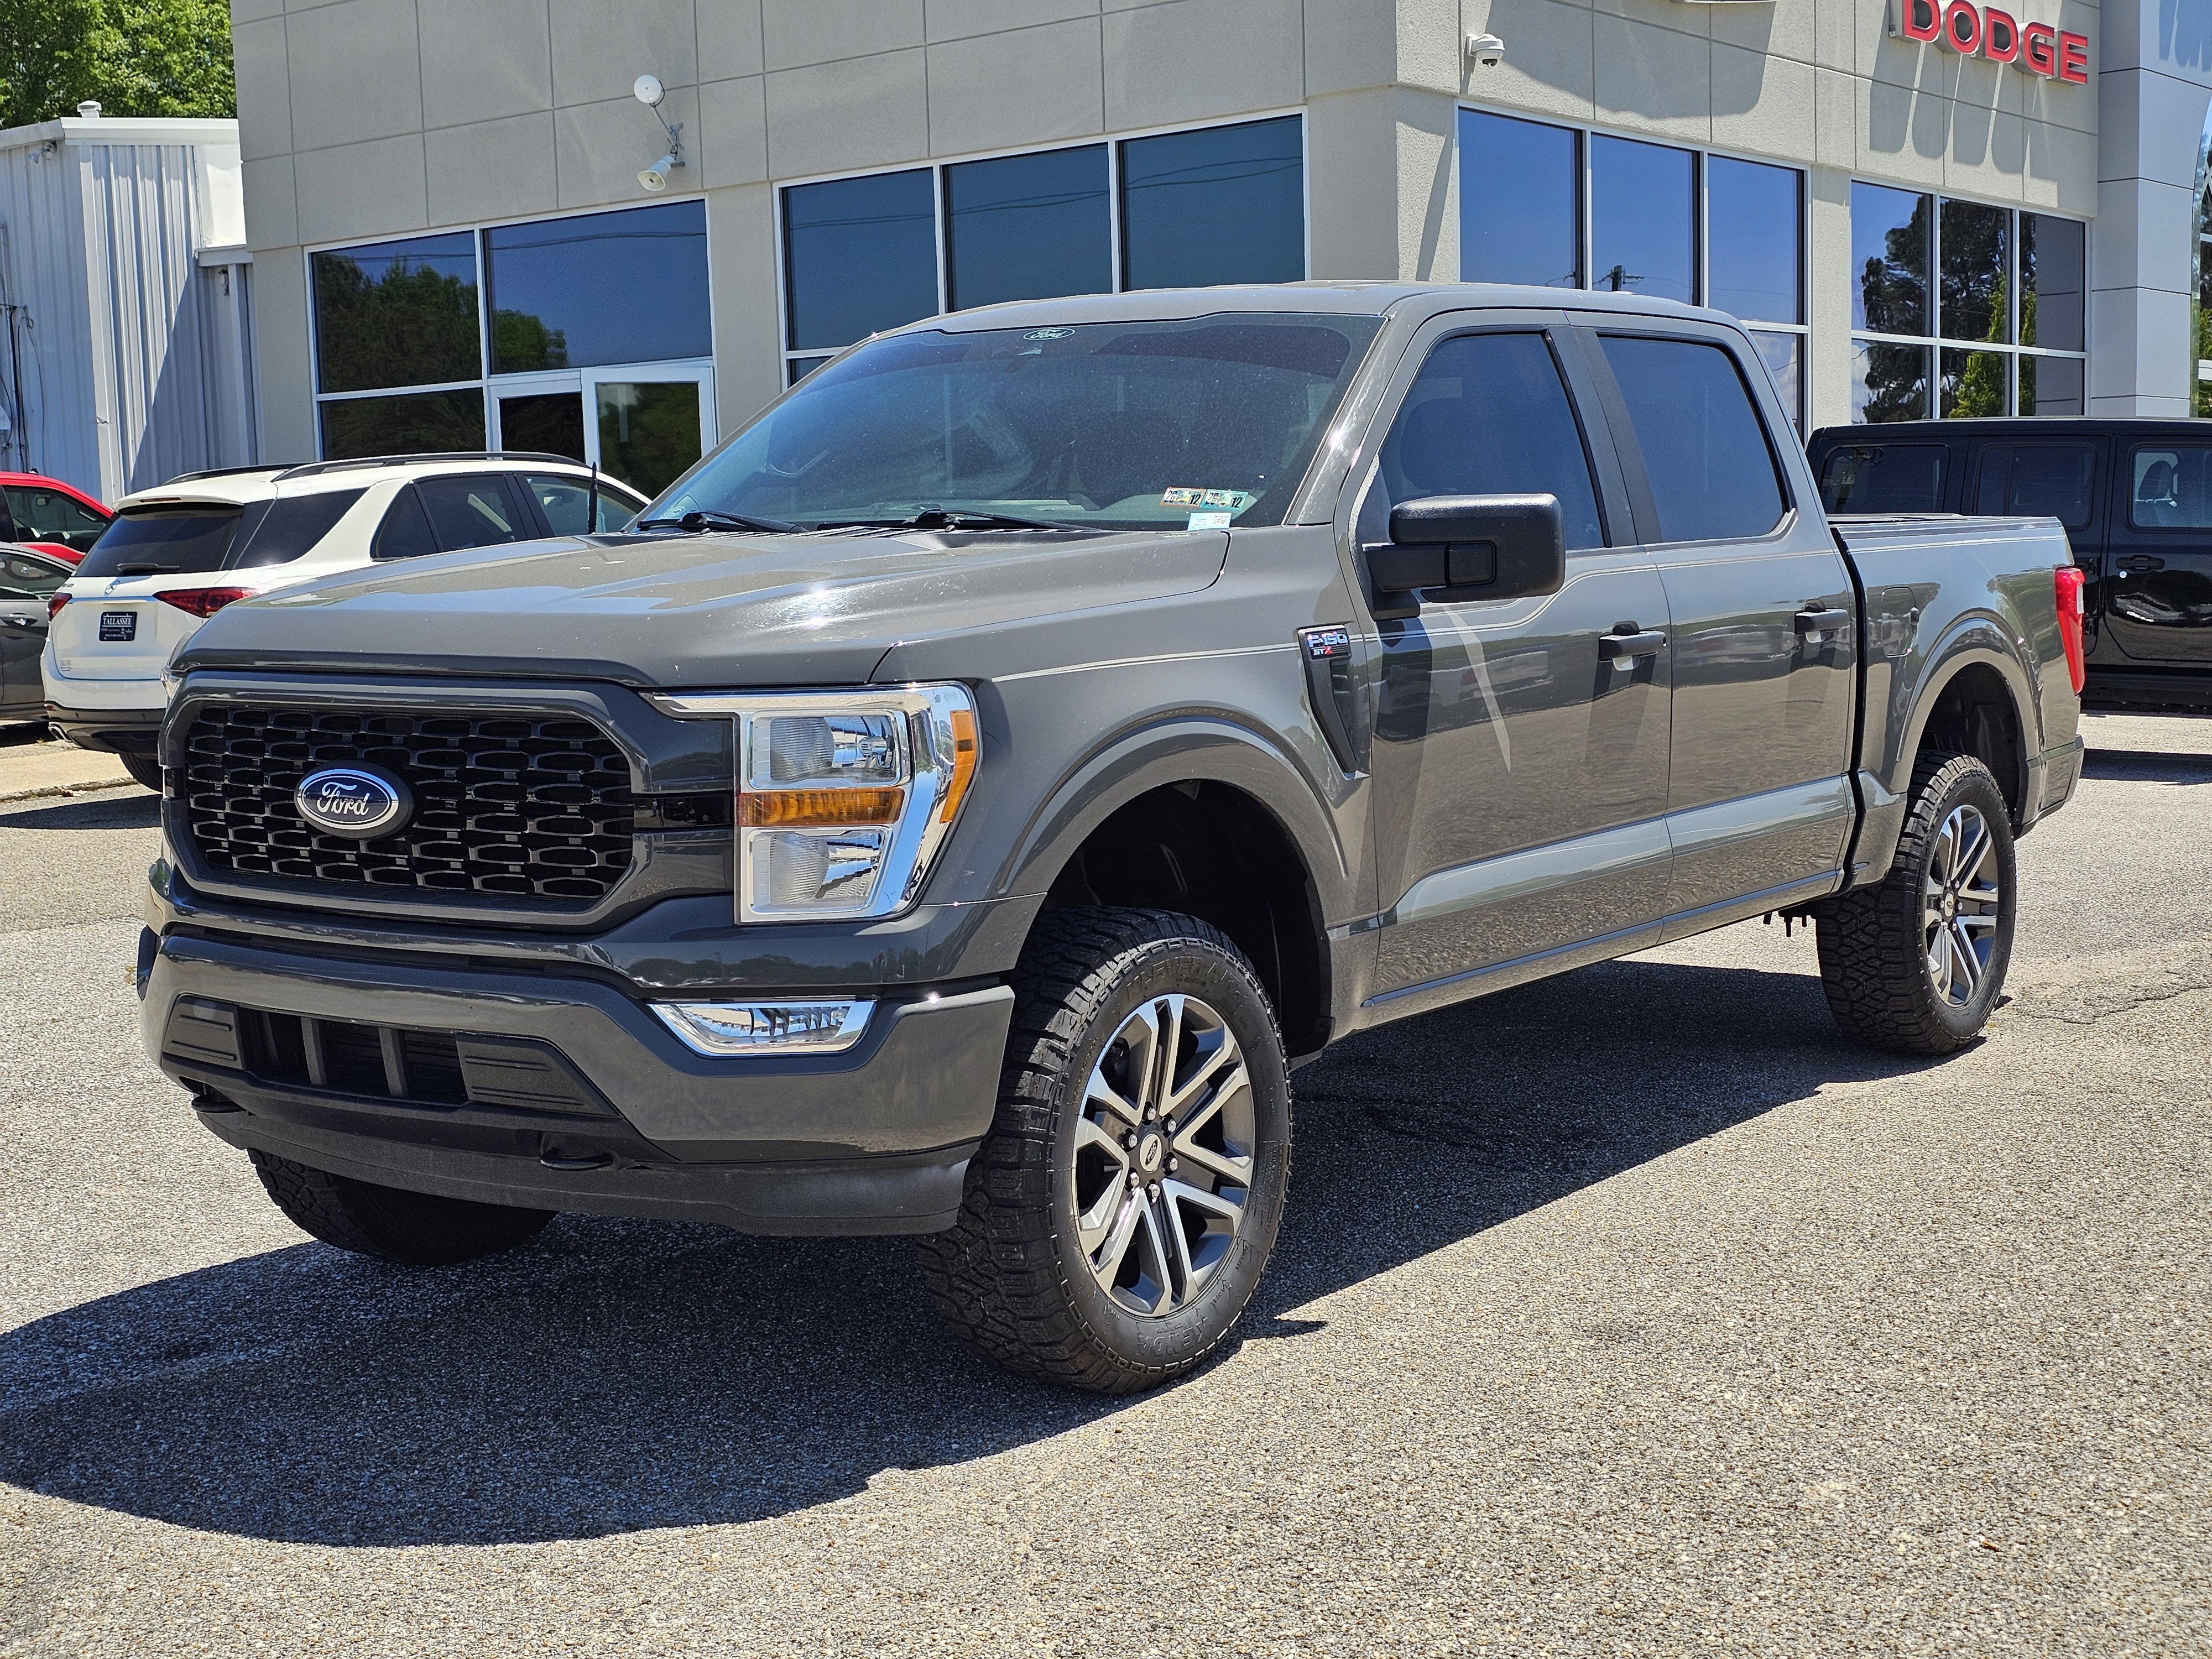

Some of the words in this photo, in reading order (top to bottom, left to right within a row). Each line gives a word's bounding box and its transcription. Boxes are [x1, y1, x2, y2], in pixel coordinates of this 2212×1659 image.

[1901, 0, 2088, 85] DODGE
[1030, 329, 1067, 338] Ford
[1189, 493, 1202, 505] 12
[1231, 497, 1243, 508] 12
[1307, 631, 1348, 648] F-150
[1313, 645, 1333, 655] STX
[316, 781, 371, 816] Ford
